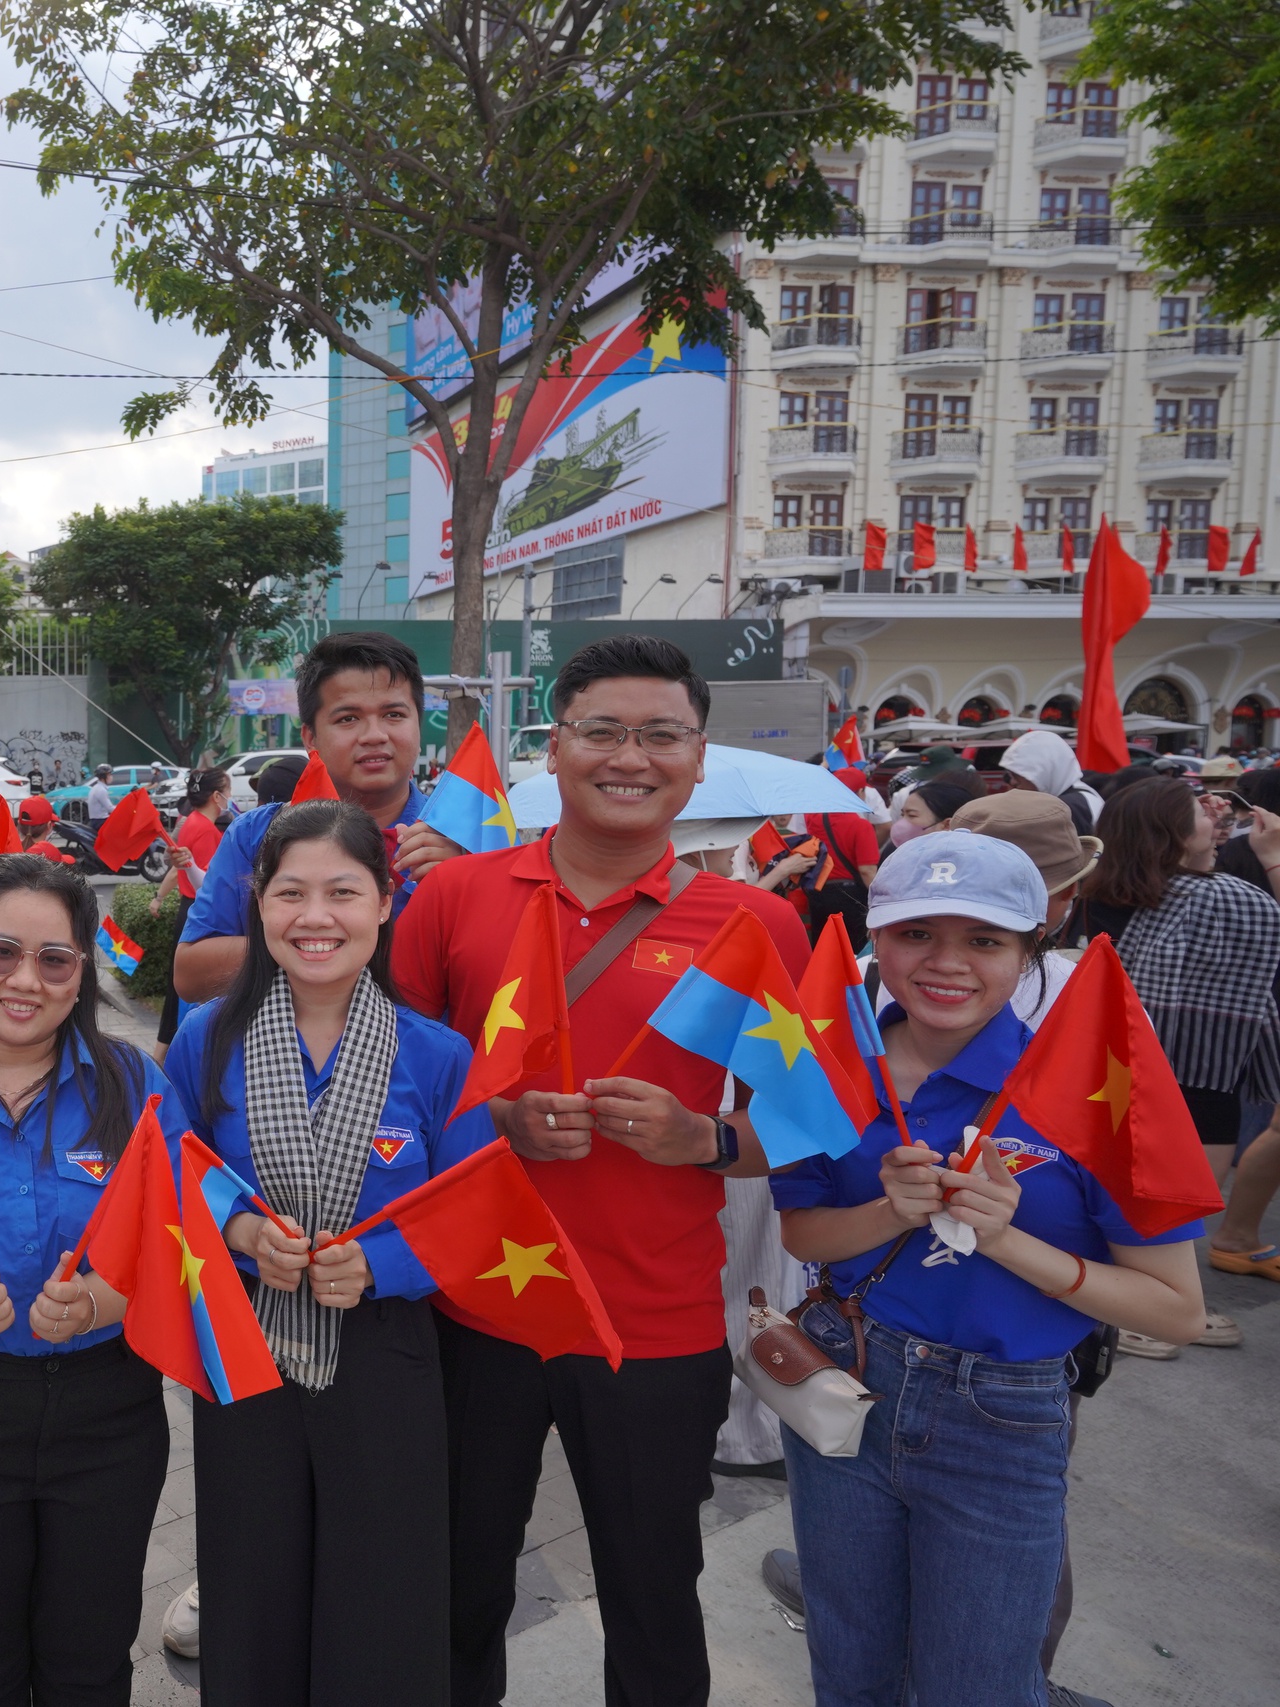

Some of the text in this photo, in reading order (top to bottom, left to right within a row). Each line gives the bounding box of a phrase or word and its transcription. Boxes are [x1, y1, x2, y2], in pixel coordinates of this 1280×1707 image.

[506, 316, 521, 336] Hy
[272, 436, 315, 450] SUNWAH
[518, 543, 542, 558] NAM,
[544, 527, 574, 550] THỐNG
[577, 514, 603, 539] NHẤT
[606, 507, 627, 531] ĐẤT
[630, 498, 662, 524] NƯỚC
[927, 862, 958, 885] R
[1037, 1149, 1056, 1158] NAM
